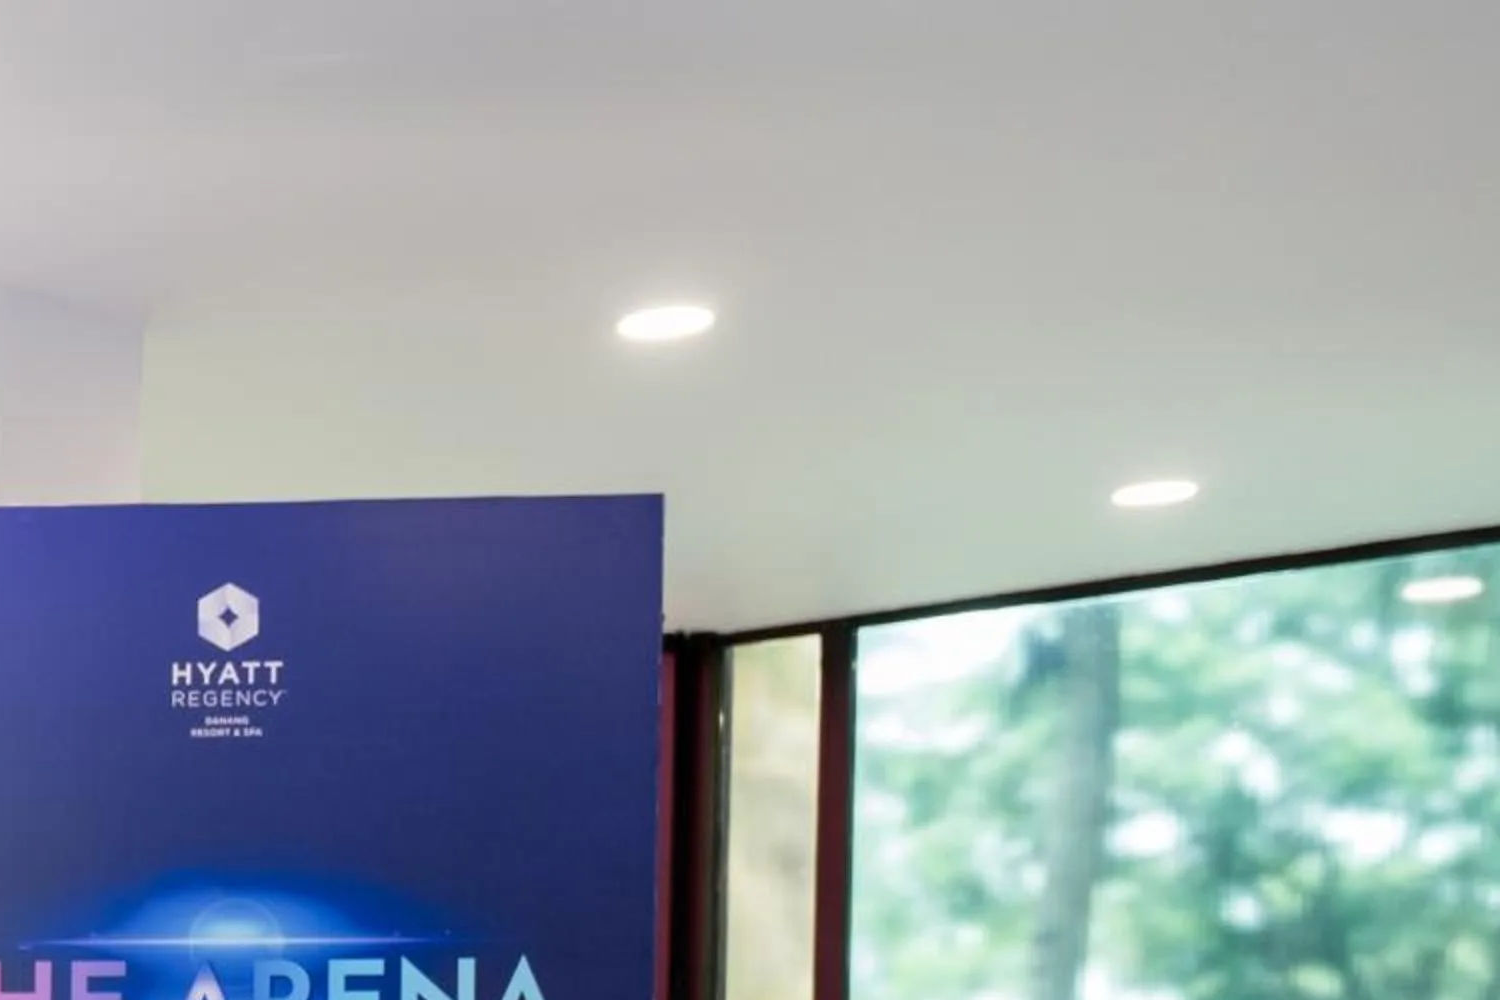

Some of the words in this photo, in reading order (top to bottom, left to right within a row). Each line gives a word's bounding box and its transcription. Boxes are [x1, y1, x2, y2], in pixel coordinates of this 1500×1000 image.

[172, 661, 284, 686] HYATT
[171, 689, 283, 708] REGENCY
[190, 728, 231, 738] RESORT
[243, 728, 263, 737] SPA
